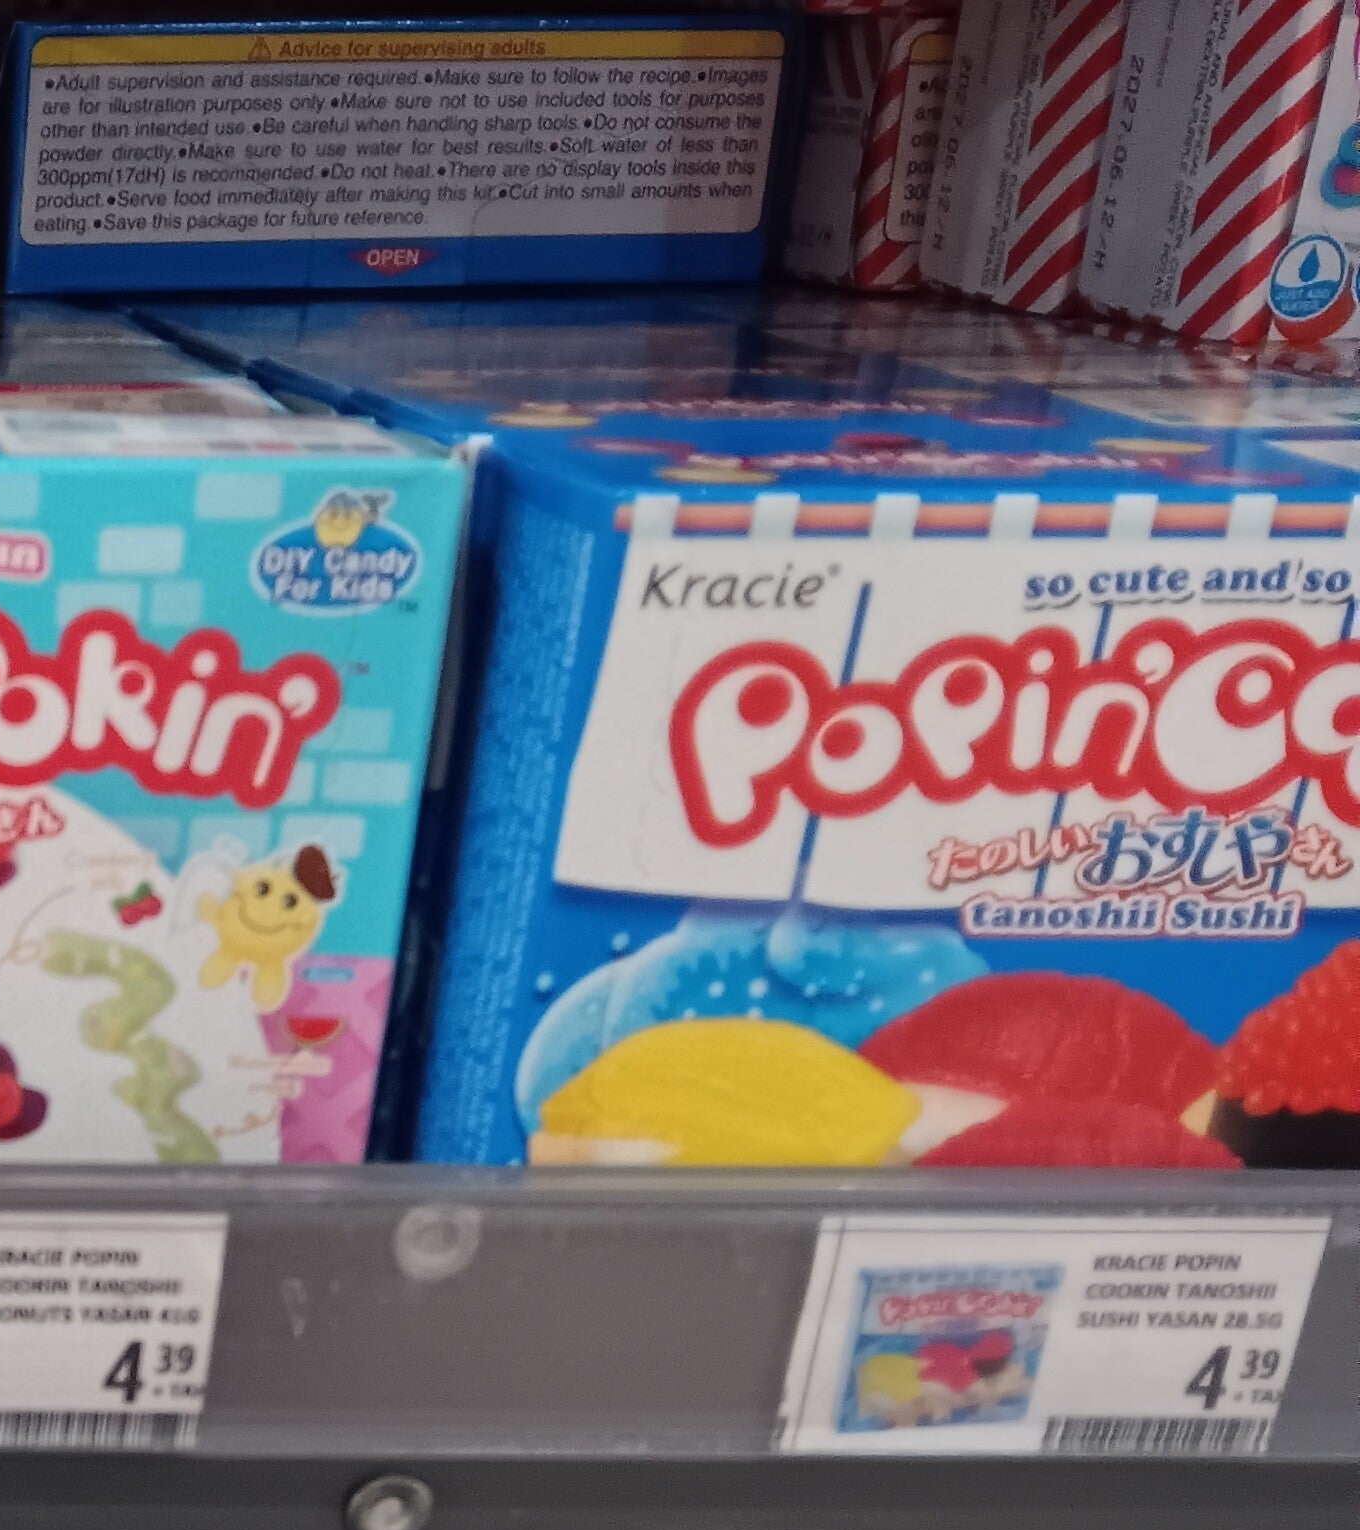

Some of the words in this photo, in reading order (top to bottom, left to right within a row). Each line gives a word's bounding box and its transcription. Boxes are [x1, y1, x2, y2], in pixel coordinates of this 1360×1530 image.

[279, 39, 342, 58] Advice
[346, 38, 373, 57] for
[380, 39, 484, 62] supervising
[490, 37, 546, 56] adults
[108, 72, 207, 92] supervision
[251, 71, 340, 88] assistance
[552, 66, 600, 85] follow
[203, 96, 283, 117] purposes
[134, 118, 209, 138] intended
[291, 116, 349, 135] careful
[405, 114, 478, 133] handling
[38, 144, 104, 164] powder
[173, 189, 212, 207] food
[217, 188, 319, 211] immediately
[630, 182, 704, 200] amounts
[186, 212, 260, 233] package
[365, 248, 421, 267] OPEN
[261, 548, 311, 575] DIY
[324, 546, 414, 581] Candy
[270, 576, 323, 602] For
[330, 574, 396, 604] Kids
[640, 562, 825, 612] Kracie
[1024, 572, 1074, 599] so
[1089, 563, 1191, 597] cute
[1202, 561, 1286, 596] and
[1303, 572, 1352, 597] so
[929, 819, 1089, 886] たのしい
[1290, 826, 1353, 880] さん
[967, 894, 1162, 934] tanoshii
[1169, 894, 1300, 935] Sushi
[1093, 1254, 1169, 1272] KRACIE
[1174, 1254, 1242, 1272] POPIN
[1085, 1282, 1171, 1300] COOKIN
[1146, 1311, 1218, 1329] YASAN
[101, 1339, 145, 1404] 4
[1184, 1345, 1232, 1410] 4
[1239, 1348, 1282, 1380] 39
